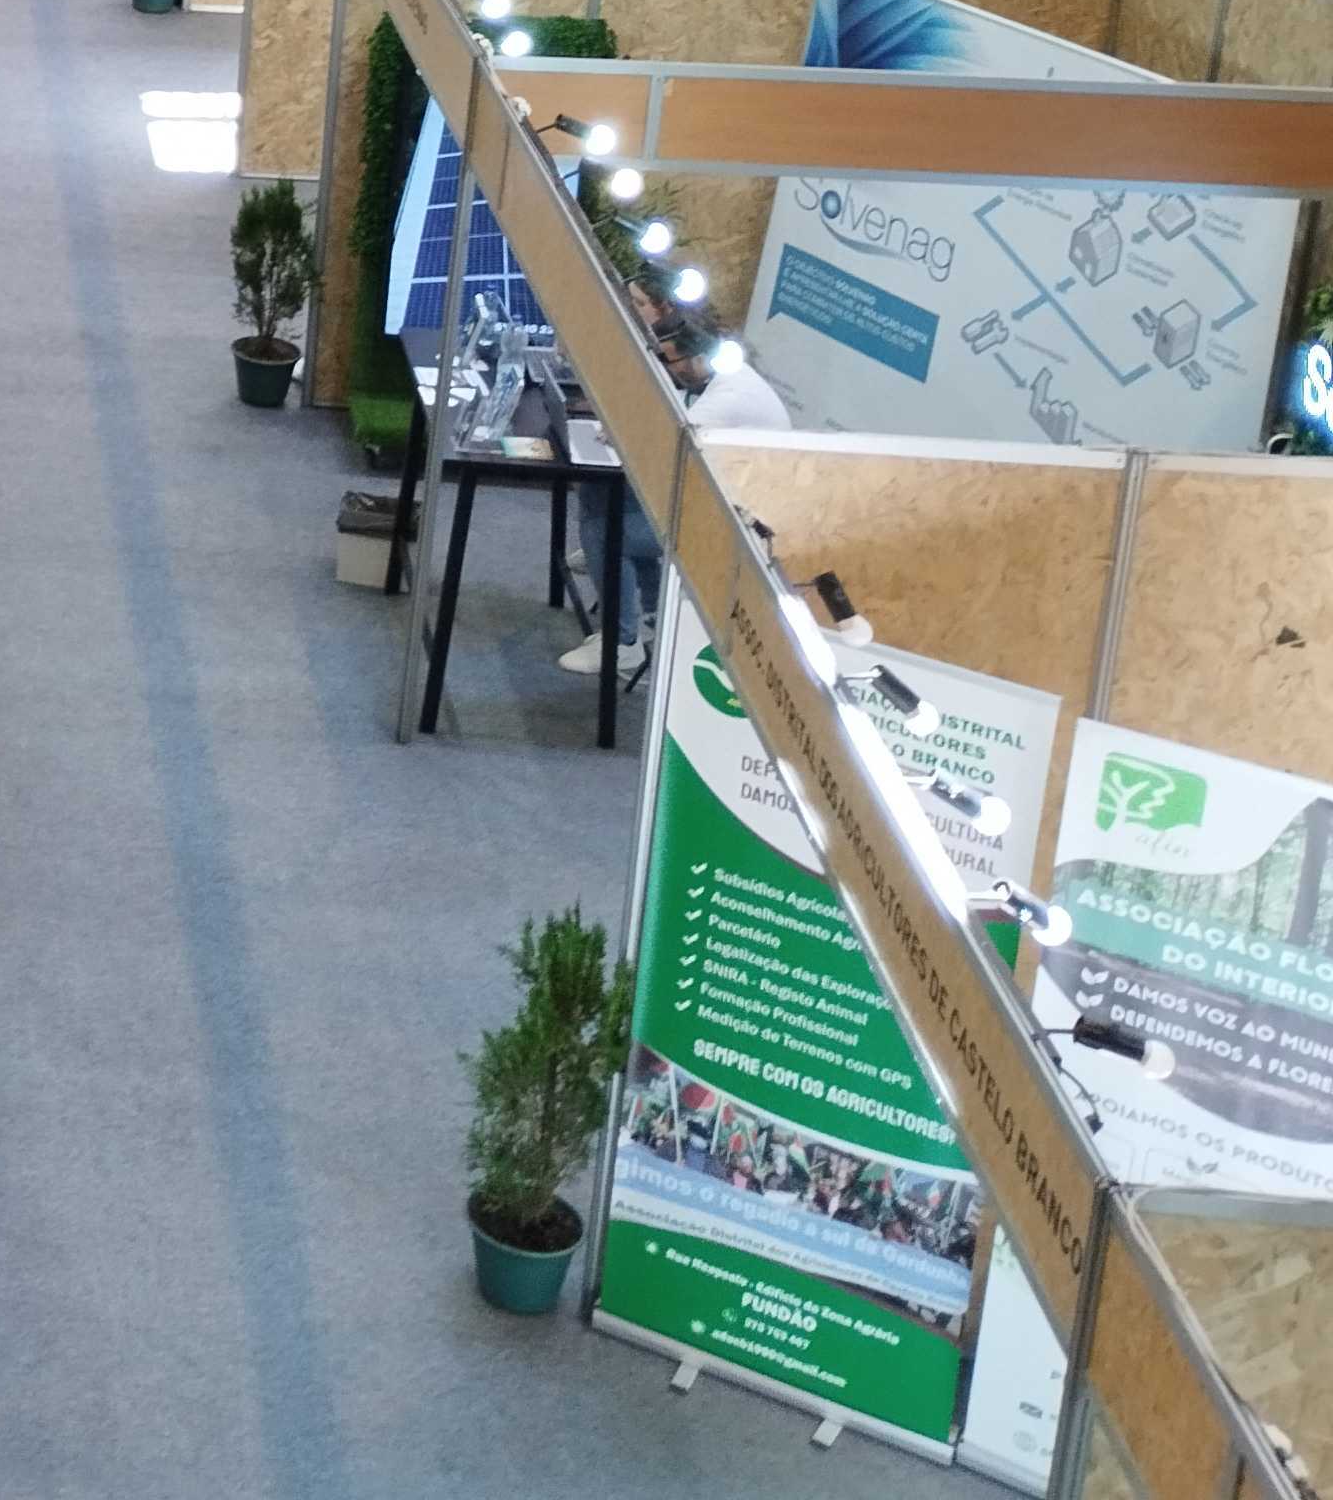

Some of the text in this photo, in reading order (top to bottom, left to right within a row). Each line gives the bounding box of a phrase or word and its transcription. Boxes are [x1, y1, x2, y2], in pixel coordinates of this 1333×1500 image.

[793, 177, 956, 283] Solvenag
[939, 712, 1026, 751] ISTRITAL
[911, 748, 996, 785] BRANCO
[713, 866, 784, 900] Subsídios
[709, 889, 830, 943] Aconselhamento
[1075, 887, 1272, 961] ASSOCIAÇÃO
[704, 935, 820, 983] Legalização das
[1160, 943, 1206, 972] DO
[699, 980, 859, 1047] Formação Profissional
[758, 975, 811, 1006] Registo
[814, 994, 870, 1028] Animal
[1112, 976, 1189, 1015] DAMOS
[1192, 1001, 1239, 1031] VOZ
[1241, 1020, 1276, 1043] AO
[696, 1003, 913, 1090] Medição de Terrenos com GPS
[835, 796, 927, 980] AGRICULTORES
[930, 968, 949, 1020] DE
[941, 1013, 1013, 1143] CASTELO
[1015, 1144, 1082, 1275] BRANCO
[1109, 1004, 1244, 1063] DEFENDEMOS
[1247, 1052, 1263, 1069] A
[692, 1037, 761, 1079] SEMPRE
[761, 1061, 800, 1089] COM
[800, 1073, 824, 1097] OS
[1195, 1130, 1226, 1155] OS
[741, 1291, 818, 1333] FUNDÃO
